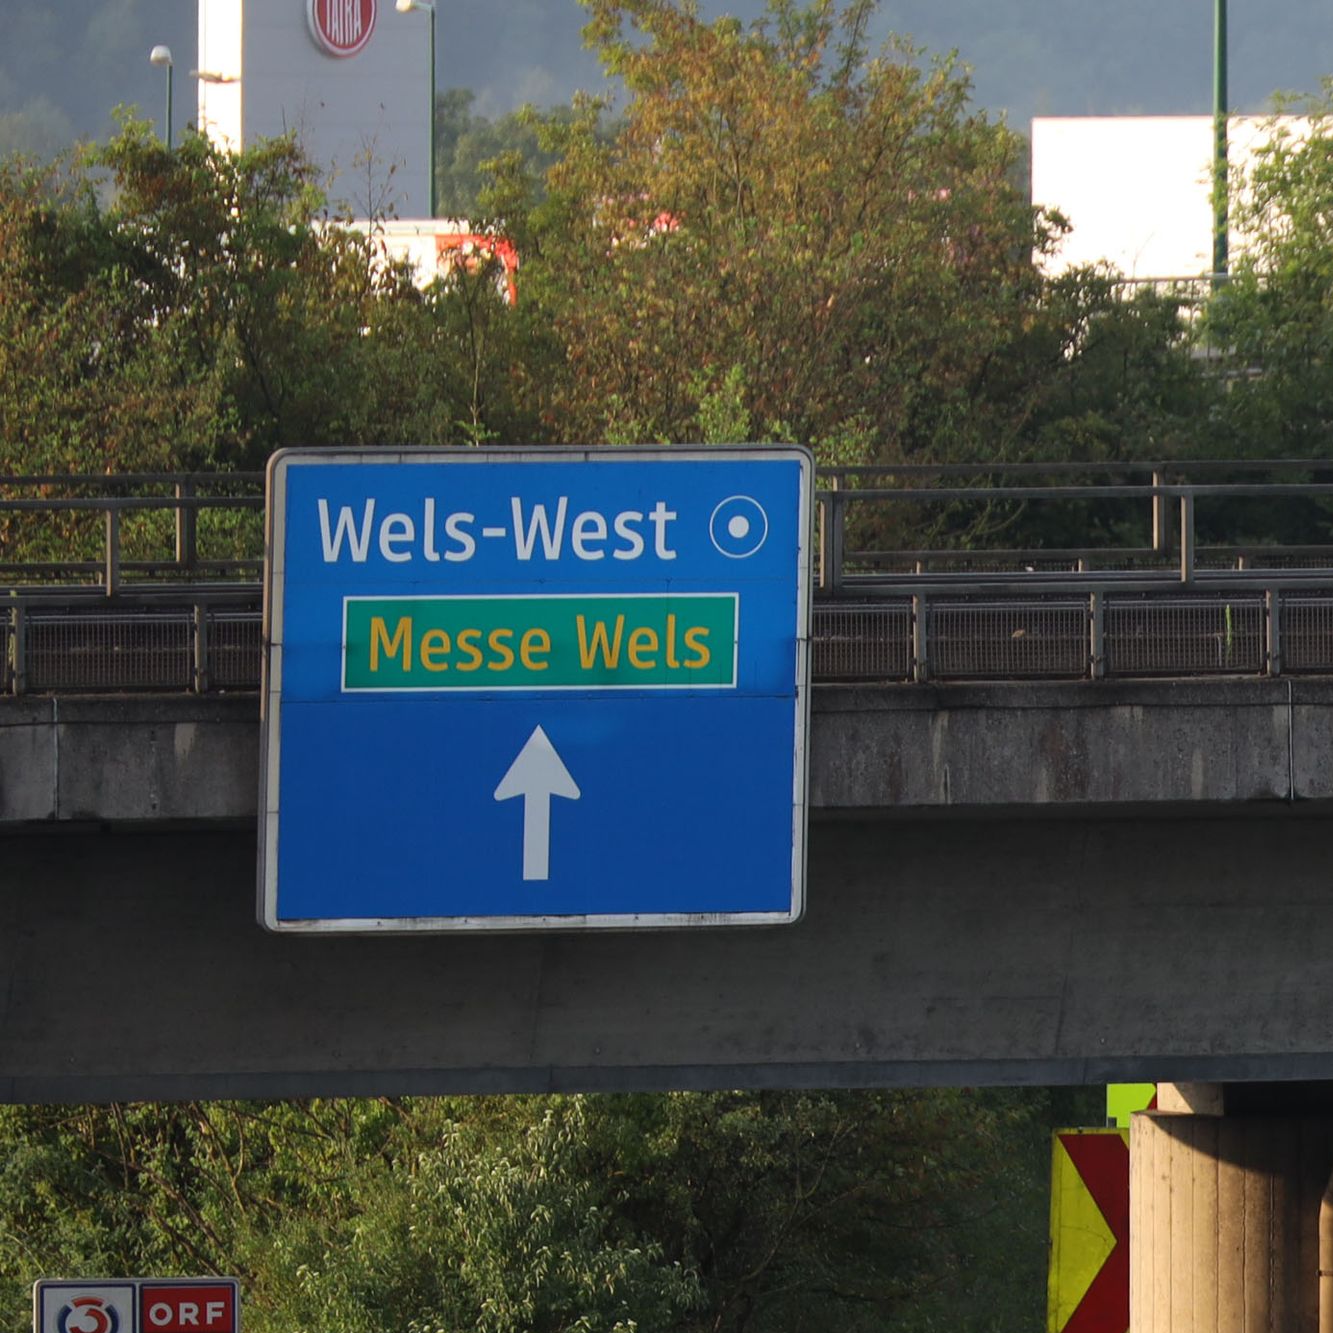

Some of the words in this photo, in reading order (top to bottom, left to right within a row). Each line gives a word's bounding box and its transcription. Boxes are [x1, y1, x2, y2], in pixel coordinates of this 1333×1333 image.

[317, 496, 678, 563] Wels-West
[369, 616, 552, 672] Messe
[576, 614, 711, 669] Wels
[149, 1302, 225, 1326] ORF
